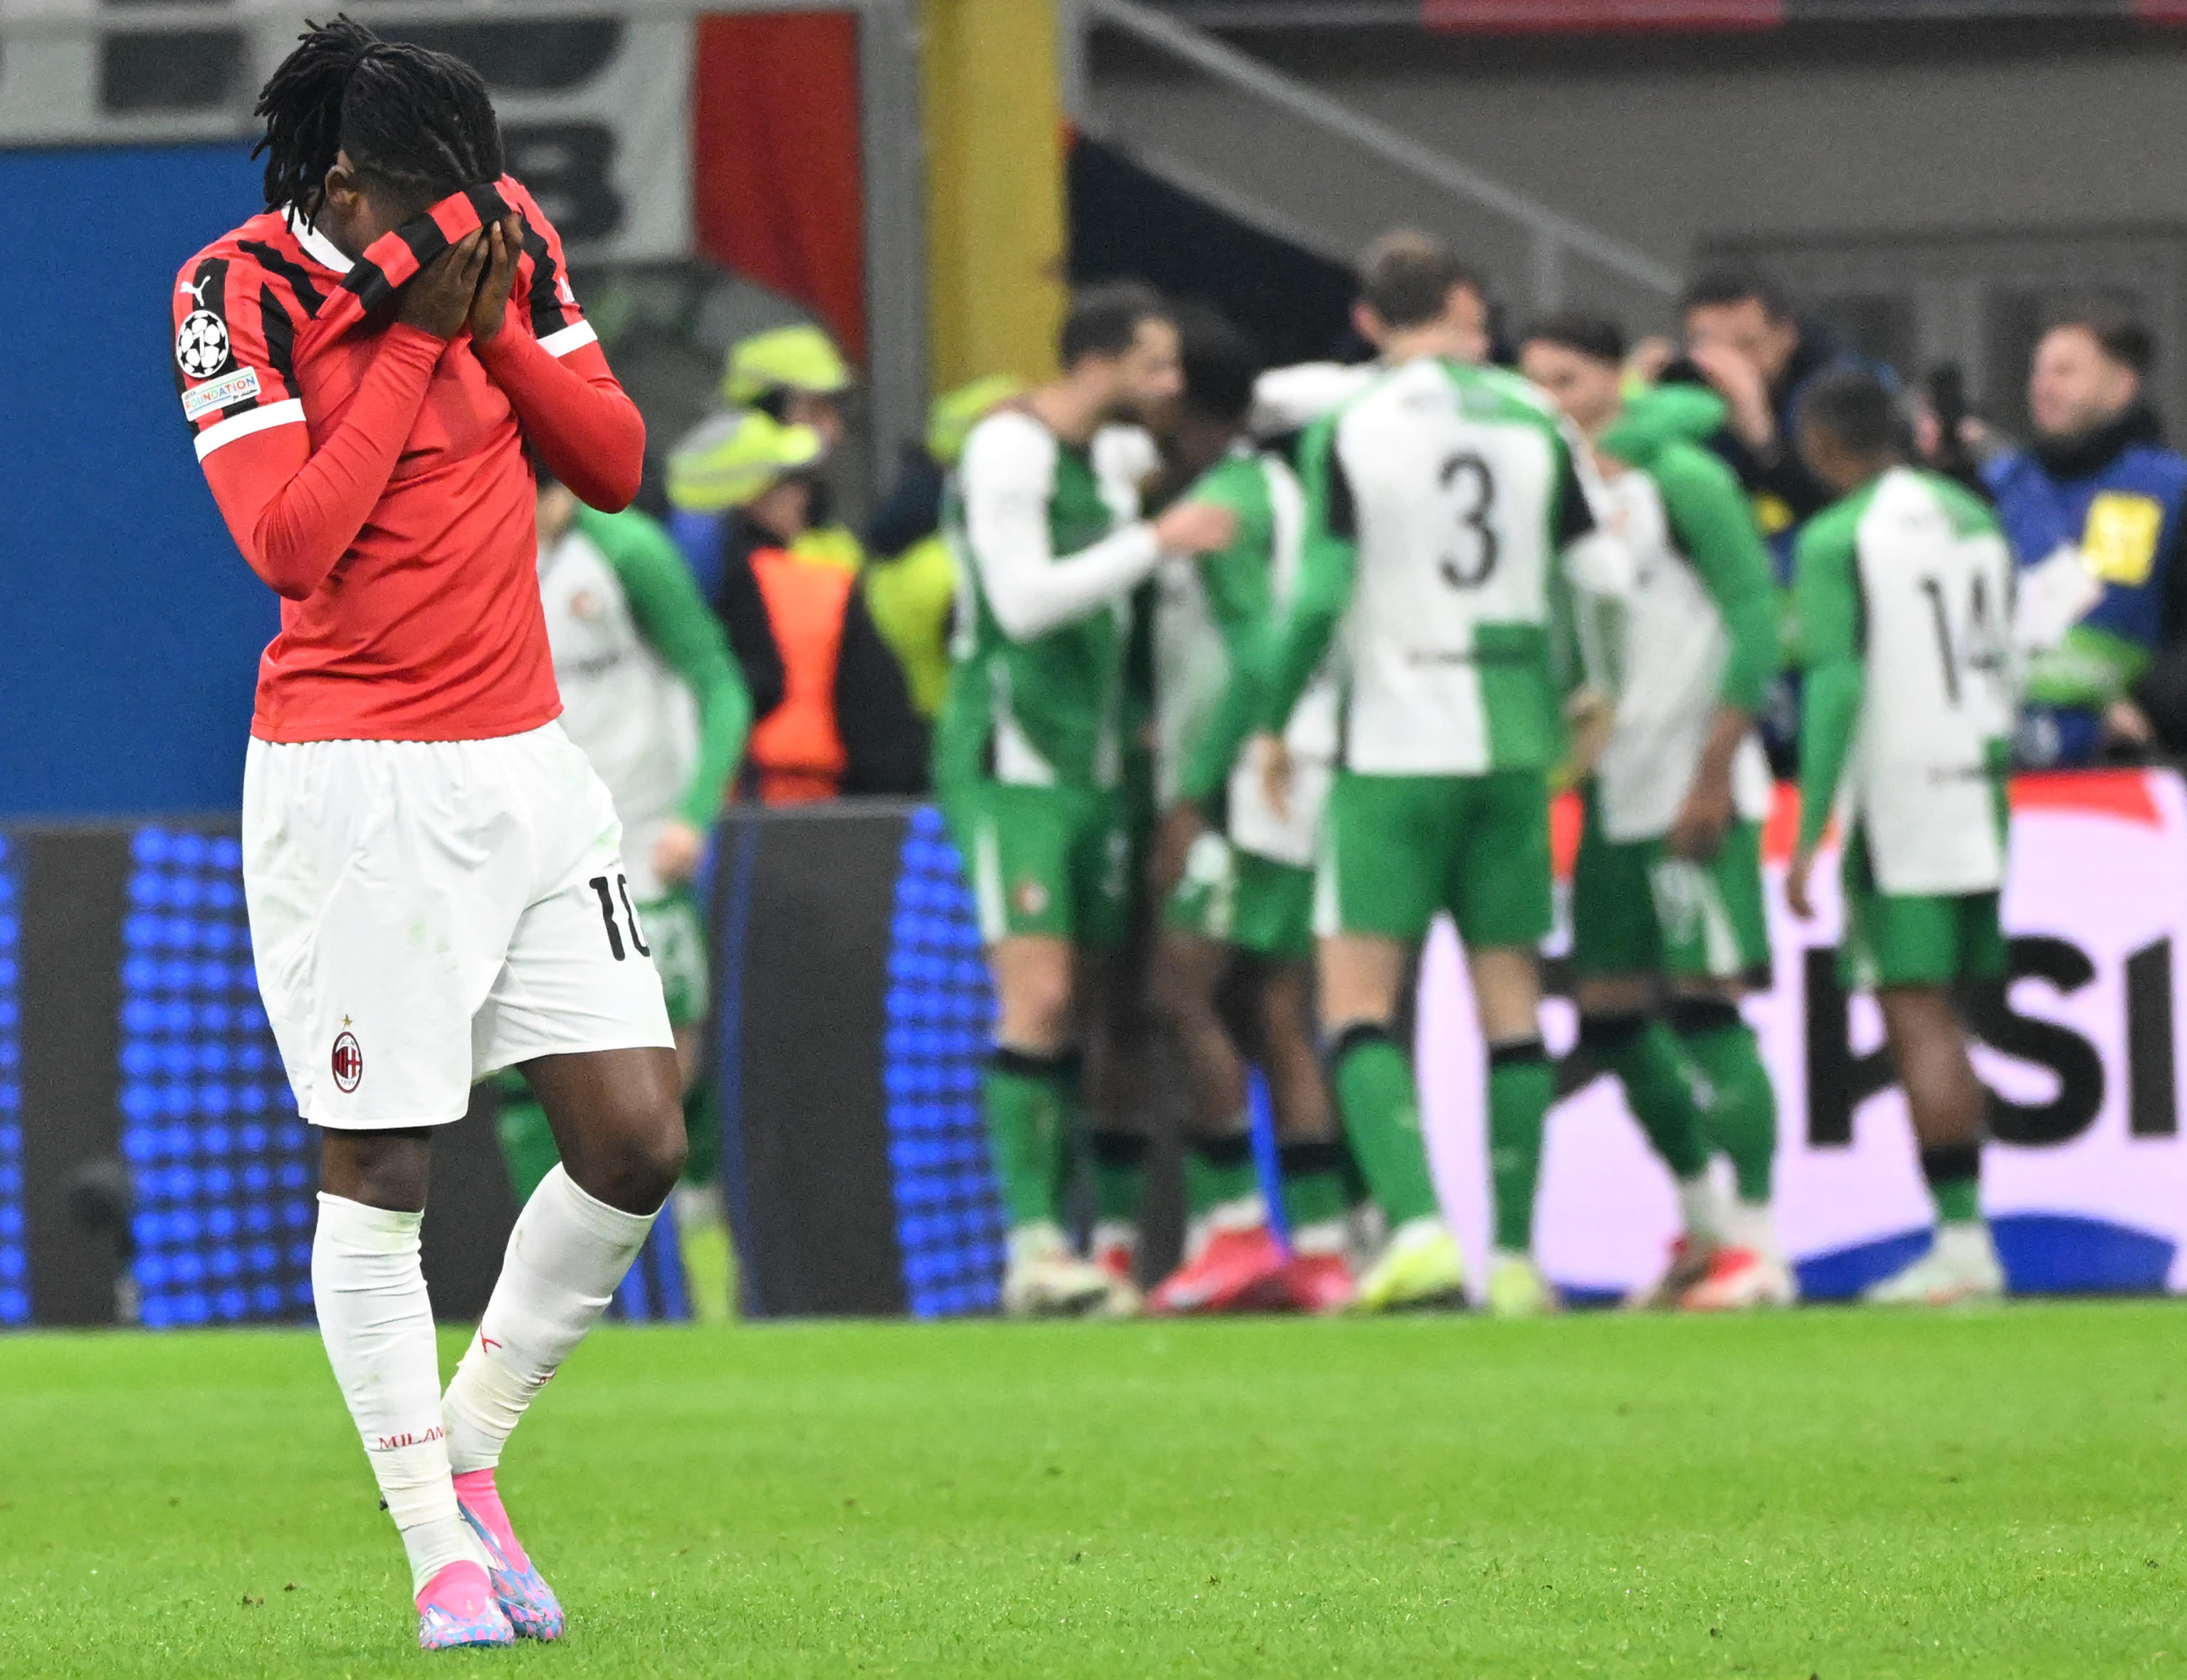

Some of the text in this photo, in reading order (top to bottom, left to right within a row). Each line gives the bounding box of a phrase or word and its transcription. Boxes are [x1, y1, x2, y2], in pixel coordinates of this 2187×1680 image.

[185, 375, 256, 409] FOUNDATION
[1438, 452, 1499, 590] 3
[1920, 568, 2018, 707] 14
